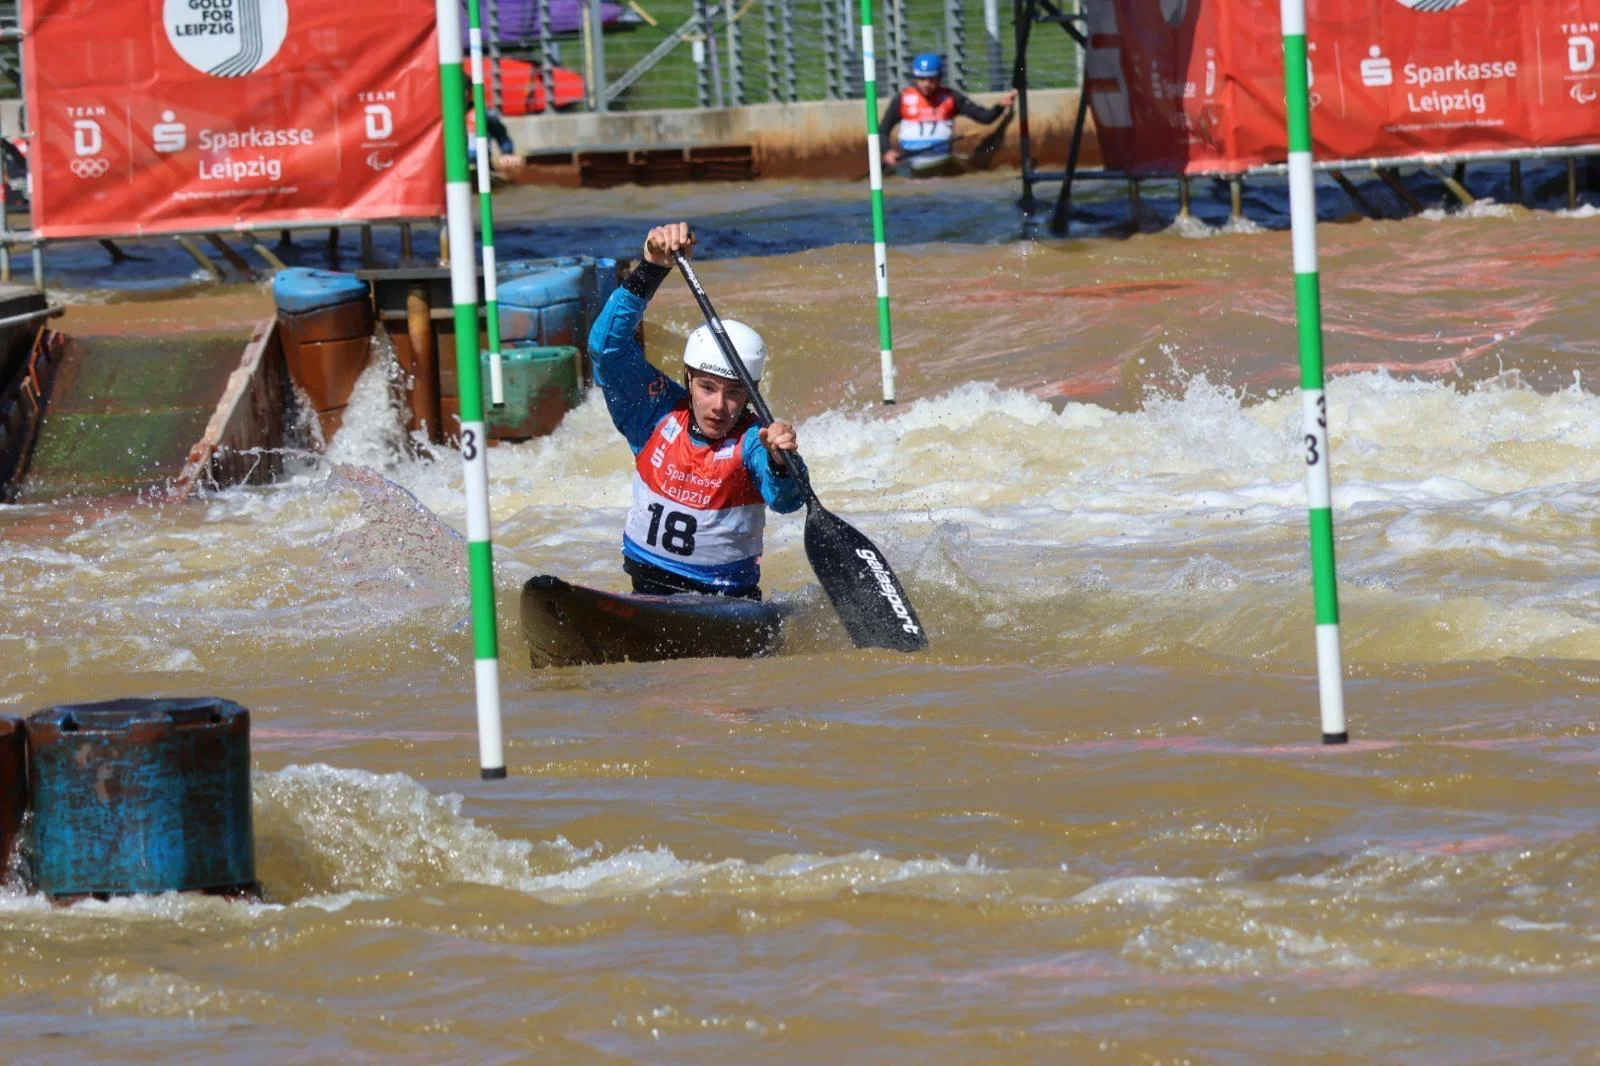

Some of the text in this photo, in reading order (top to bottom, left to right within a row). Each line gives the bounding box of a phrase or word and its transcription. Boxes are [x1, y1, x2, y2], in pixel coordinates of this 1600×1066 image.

[188, 0, 232, 9] GOLD
[202, 10, 233, 21] FOR
[176, 23, 235, 36] LEIPZIG
[1560, 22, 1599, 34] TEAM
[1568, 35, 1595, 73] D
[1403, 59, 1517, 88] Sparkasse
[357, 89, 396, 102] TEAM
[1408, 88, 1487, 115] Leipzig
[66, 106, 106, 117] TEAM
[364, 104, 393, 141] D
[74, 119, 102, 156] D
[198, 126, 315, 154] Sparkasse
[918, 121, 937, 137] 17
[199, 154, 282, 182] Leipzig
[879, 263, 885, 278] 1
[700, 362, 739, 378] galaspo
[463, 428, 477, 461] 3
[1304, 433, 1319, 466] 3
[665, 463, 723, 489] Sparkasse
[661, 480, 712, 505] Leipzig
[646, 502, 698, 557] 18
[855, 548, 919, 635] galasport
